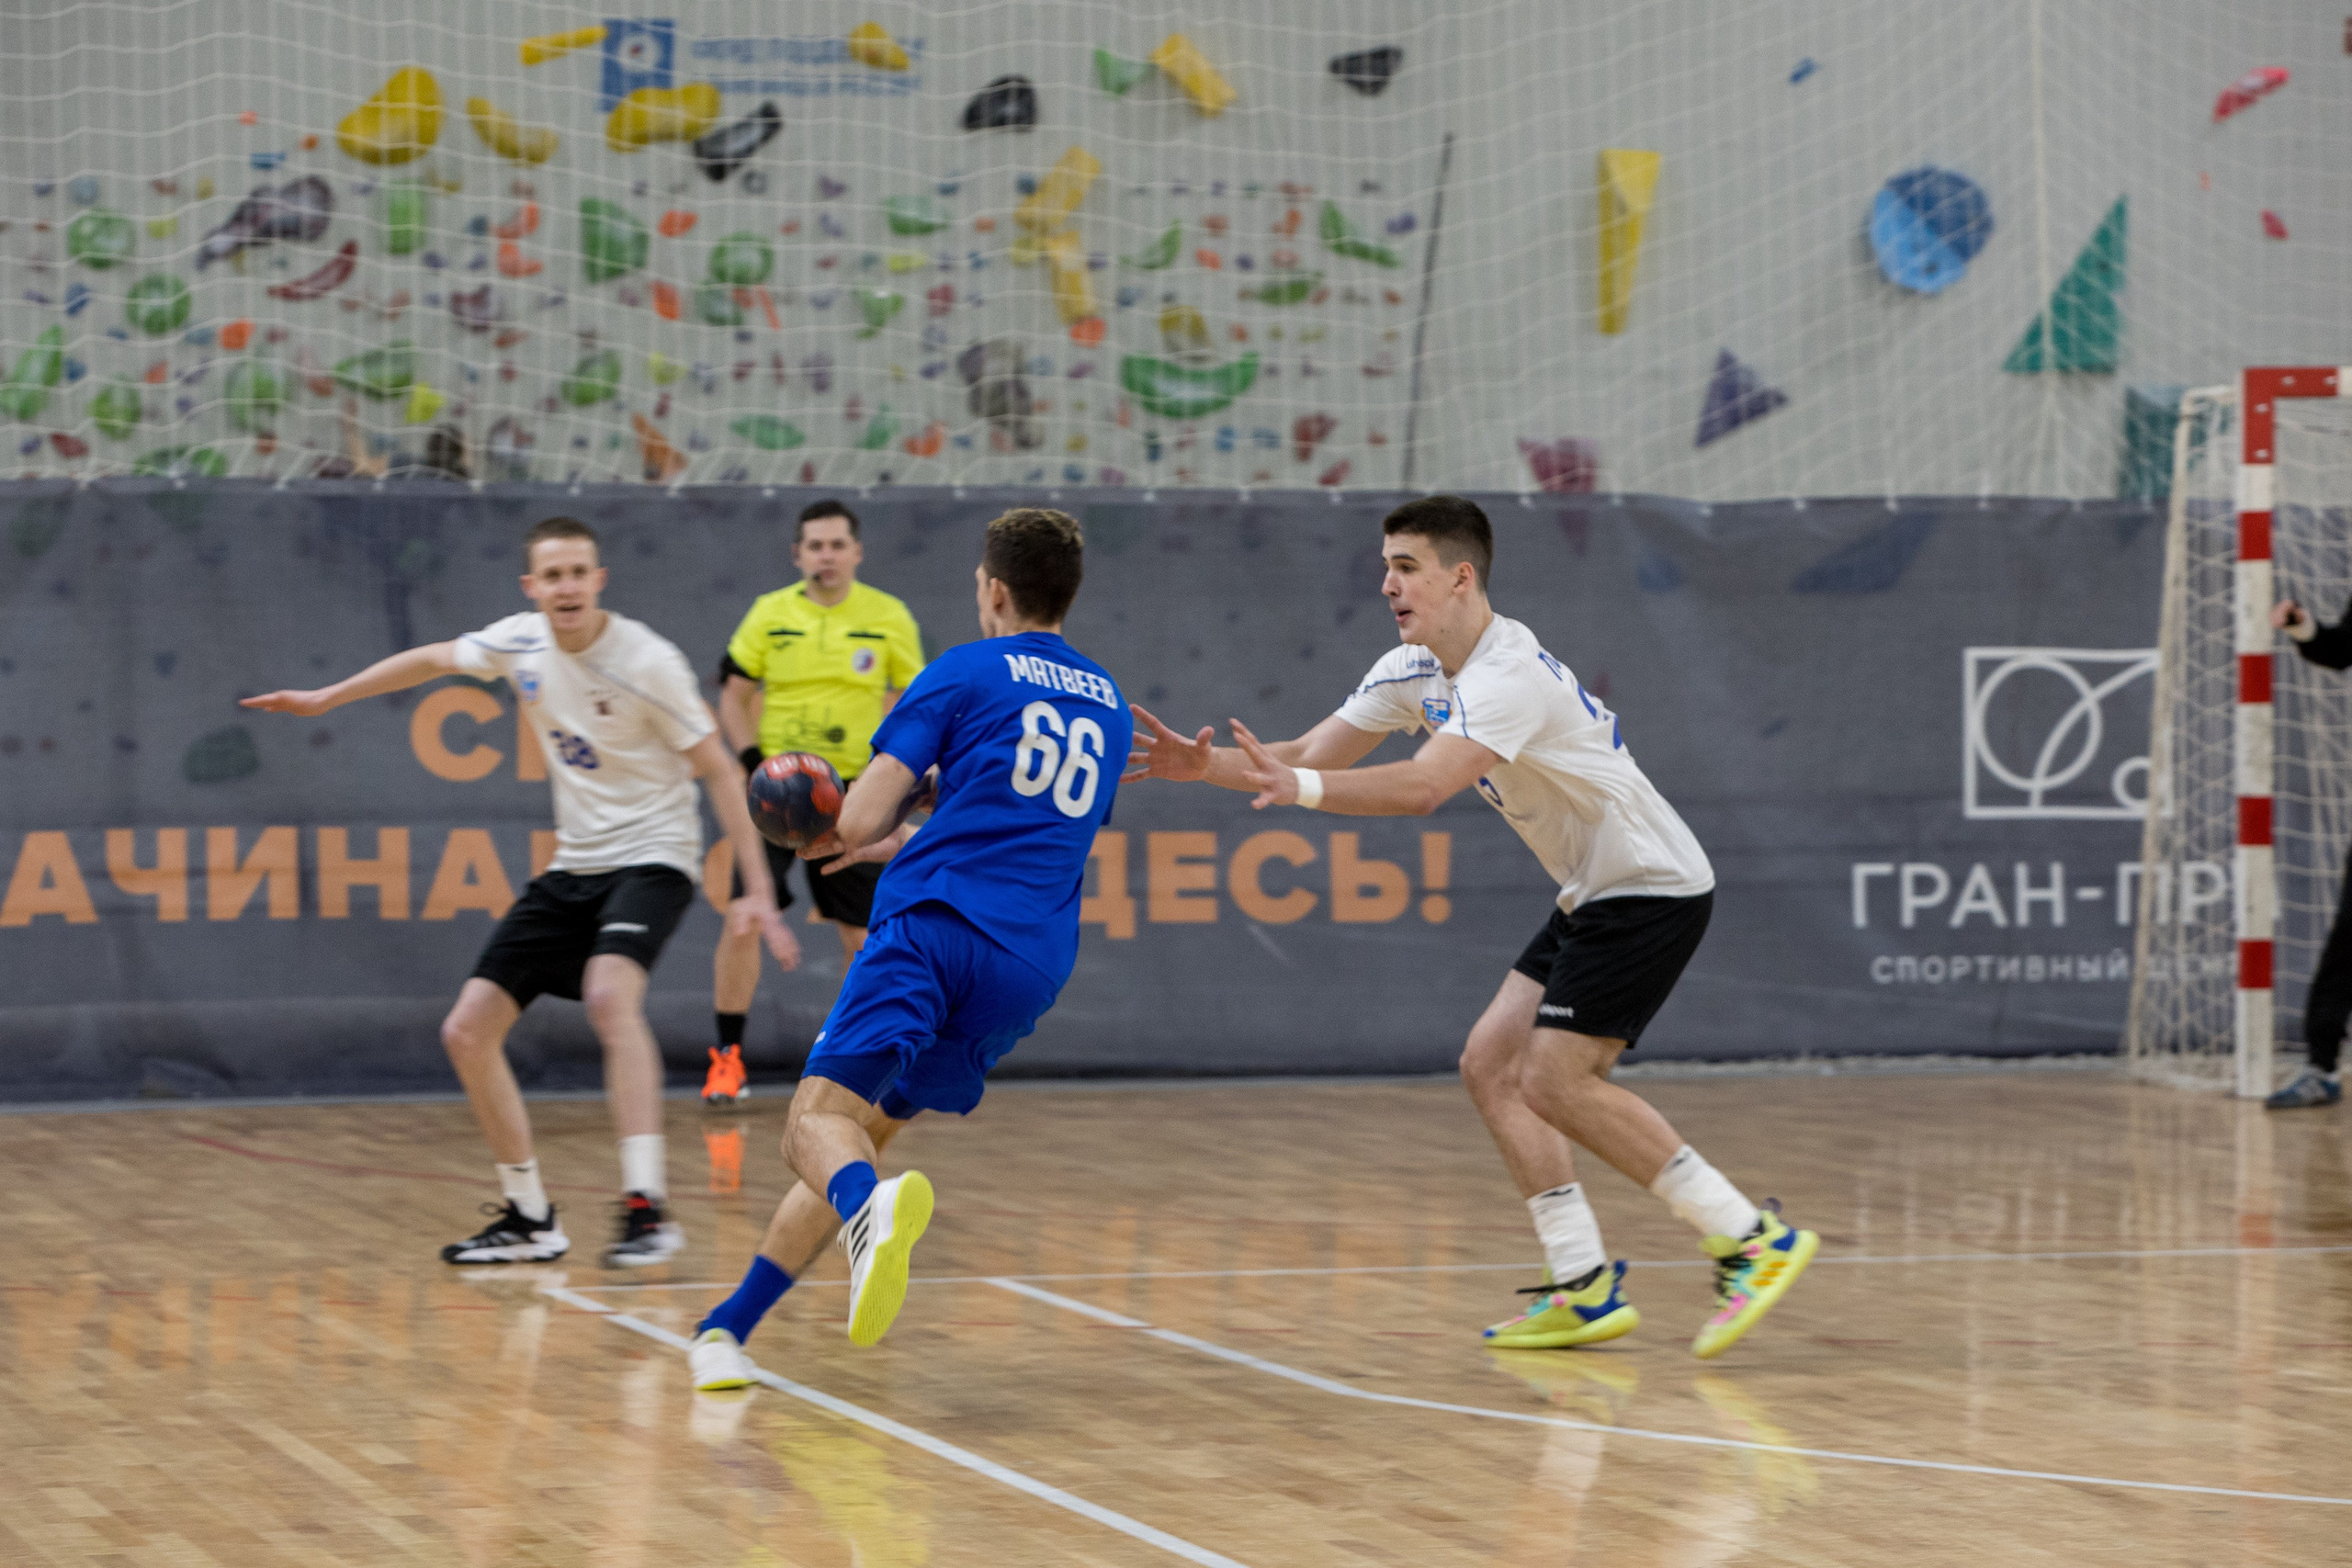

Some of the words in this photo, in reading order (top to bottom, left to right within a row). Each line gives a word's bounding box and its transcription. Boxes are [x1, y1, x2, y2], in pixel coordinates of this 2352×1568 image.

[1003, 653, 1118, 709] МАТВЕЕВ
[1011, 699, 1105, 818] 66
[1080, 830, 1452, 939] ДЕСЬ!
[1851, 862, 2280, 927] ГРАН-ПР
[1870, 948, 2129, 984] СПОРТИВНЫЙ
